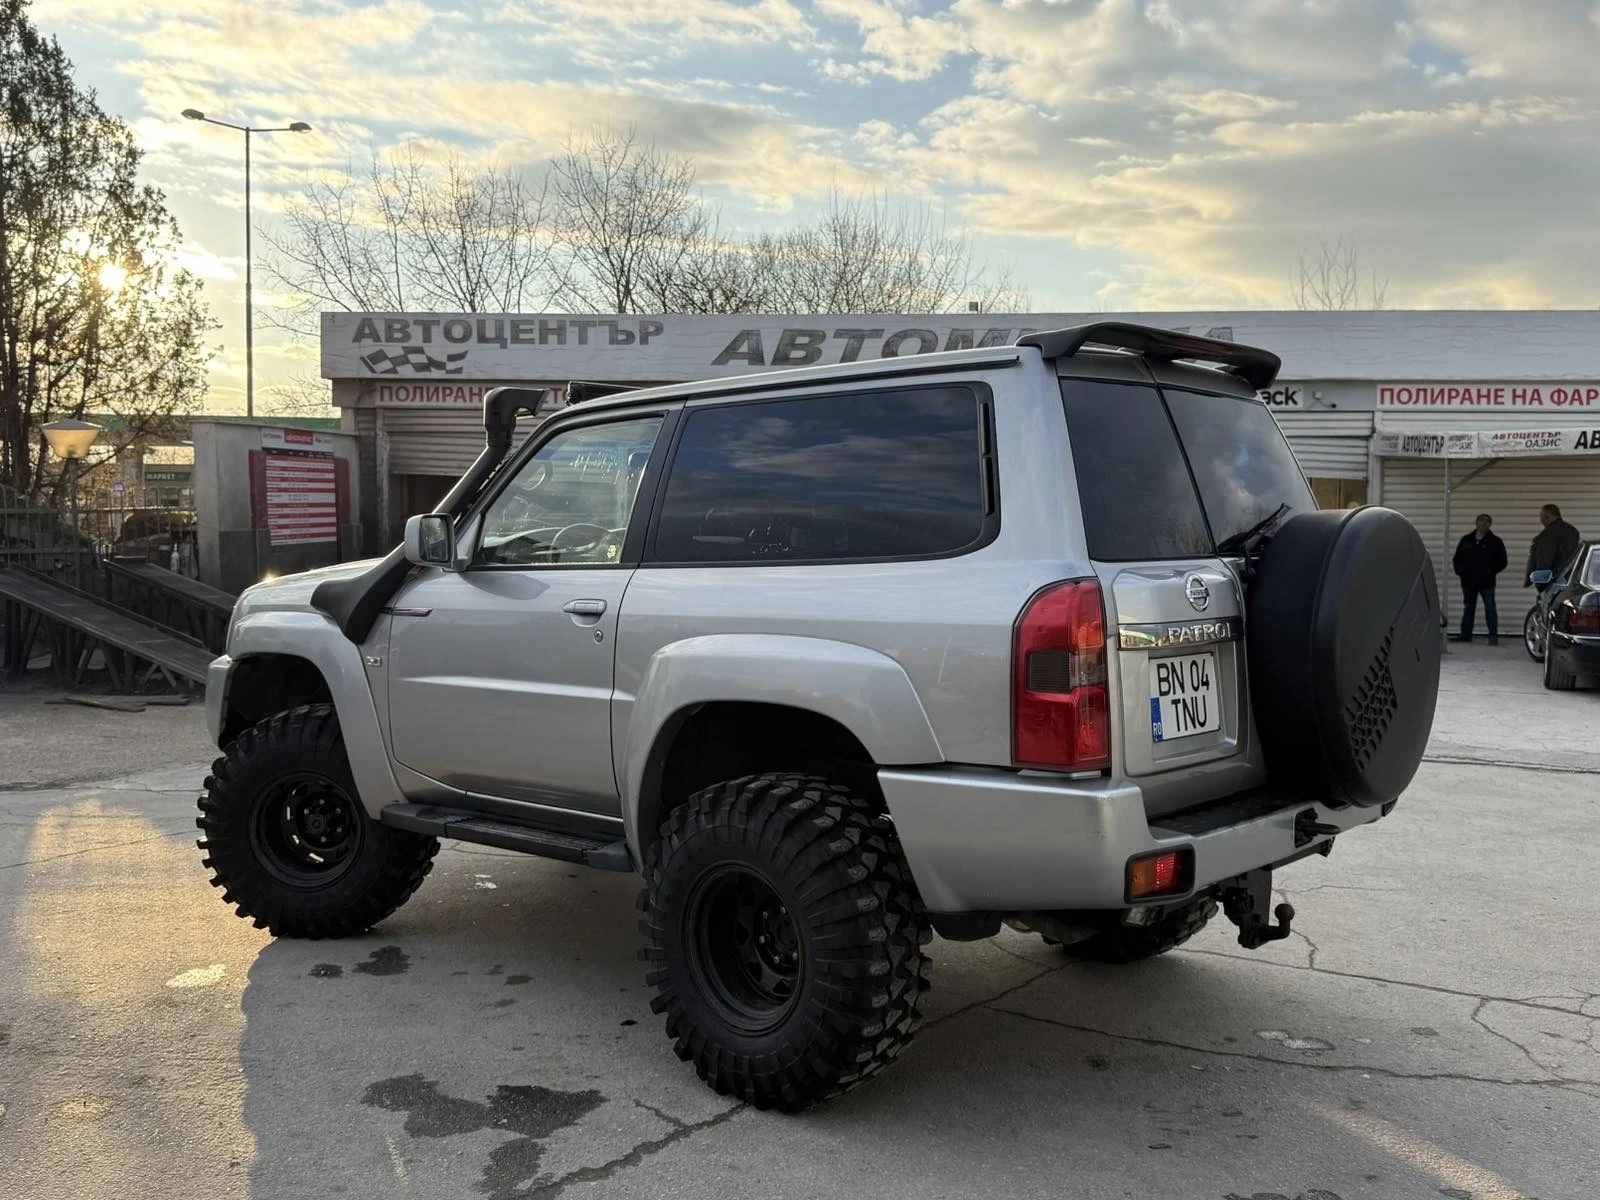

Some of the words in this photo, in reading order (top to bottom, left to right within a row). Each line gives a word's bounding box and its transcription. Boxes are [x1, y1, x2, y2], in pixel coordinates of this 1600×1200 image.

[352, 317, 664, 349] АВТОЦЕНТЪР
[1261, 386, 1298, 406] ack
[1380, 387, 1505, 406] ПОЛИРАНЕ
[1512, 388, 1543, 405] НА
[1550, 387, 1599, 406] ФАР
[1525, 438, 1561, 448] ОАЗИС
[1157, 661, 1185, 696] BN
[1190, 659, 1210, 692] 04
[1171, 695, 1207, 732] TNU
[1153, 722, 1162, 736] RO
